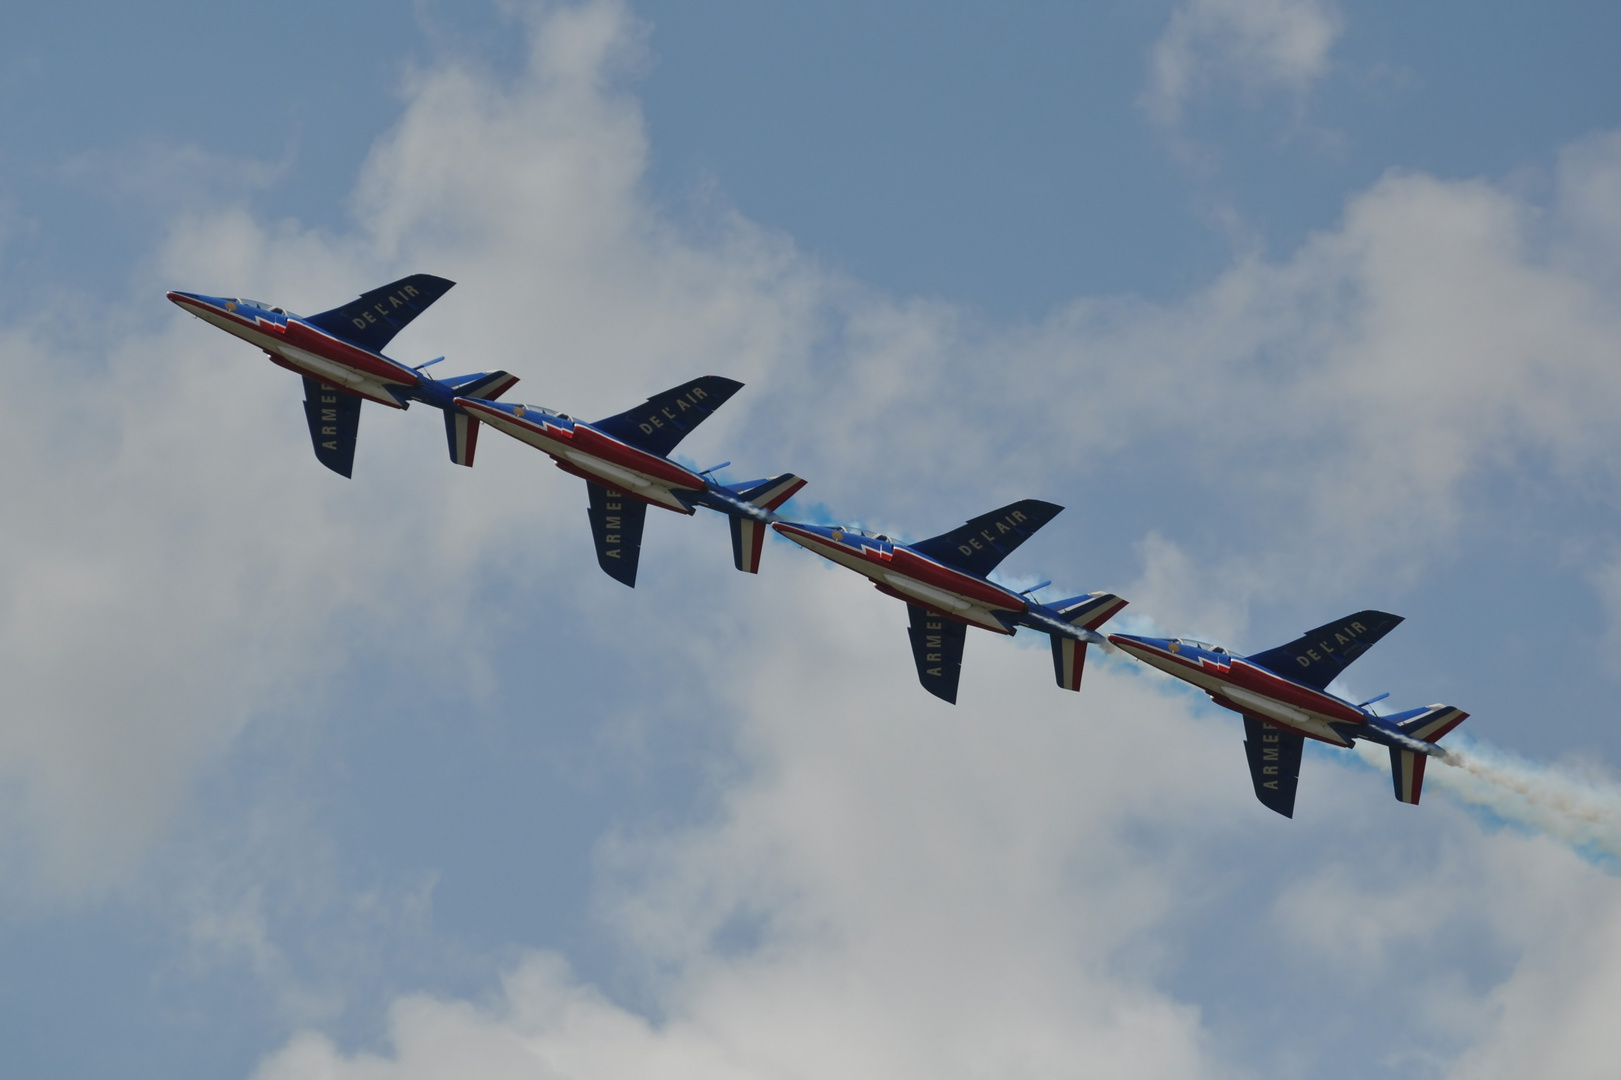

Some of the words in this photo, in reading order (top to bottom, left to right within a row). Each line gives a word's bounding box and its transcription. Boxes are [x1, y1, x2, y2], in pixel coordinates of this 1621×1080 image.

[352, 311, 377, 330] DE
[639, 415, 664, 435] DE
[958, 537, 983, 556] DE
[1296, 649, 1322, 668] DE
